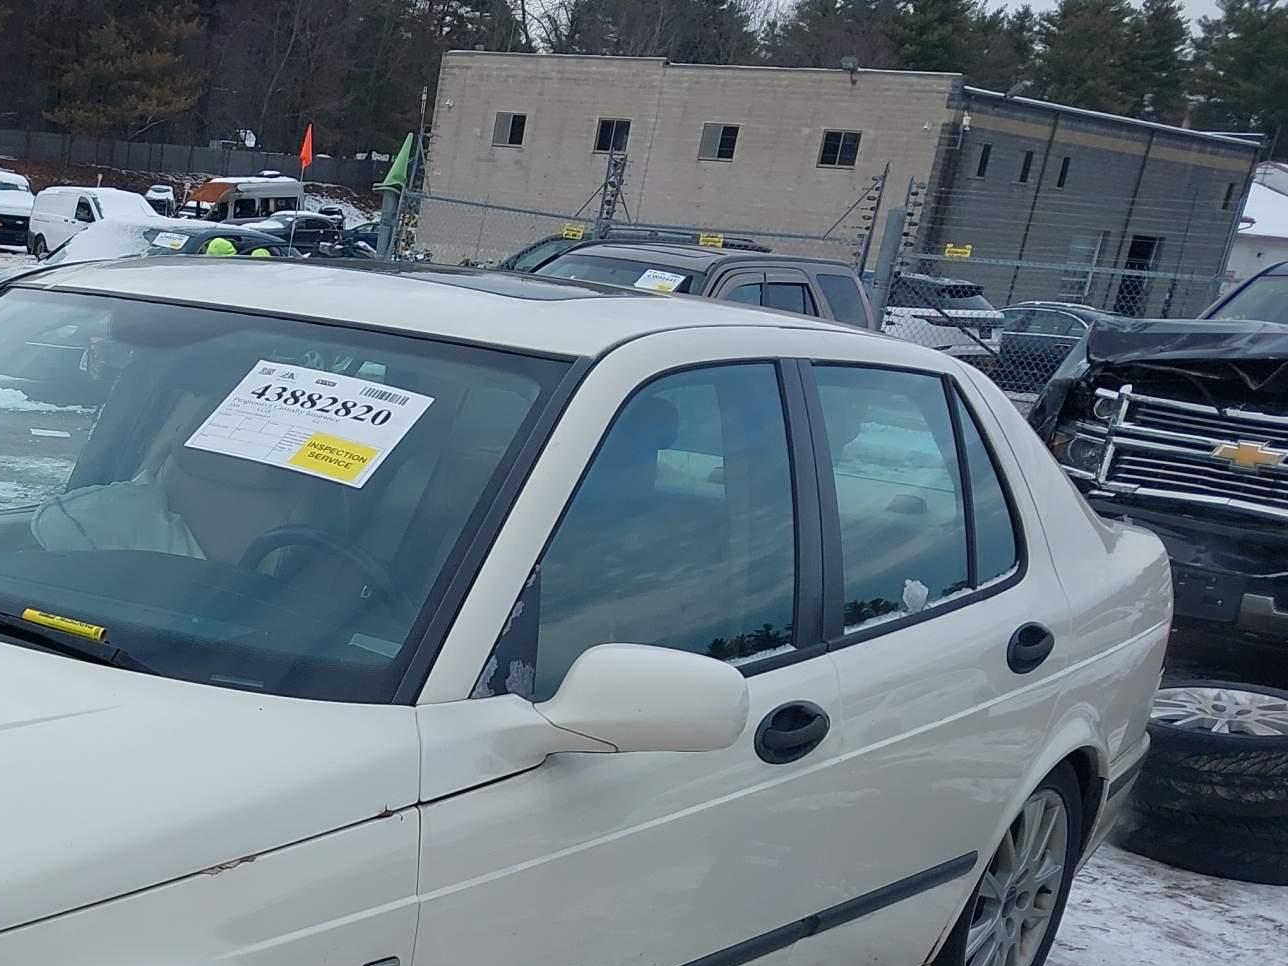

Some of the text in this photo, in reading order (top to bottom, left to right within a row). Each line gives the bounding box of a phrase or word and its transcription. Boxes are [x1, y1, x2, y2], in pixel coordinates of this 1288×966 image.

[232, 396, 273, 409] Progressive
[274, 403, 304, 416] Casualty
[306, 410, 340, 423] Insurance
[250, 384, 392, 426] 43882820
[306, 441, 368, 464] INSPECTION
[307, 451, 353, 469] SERVICE
